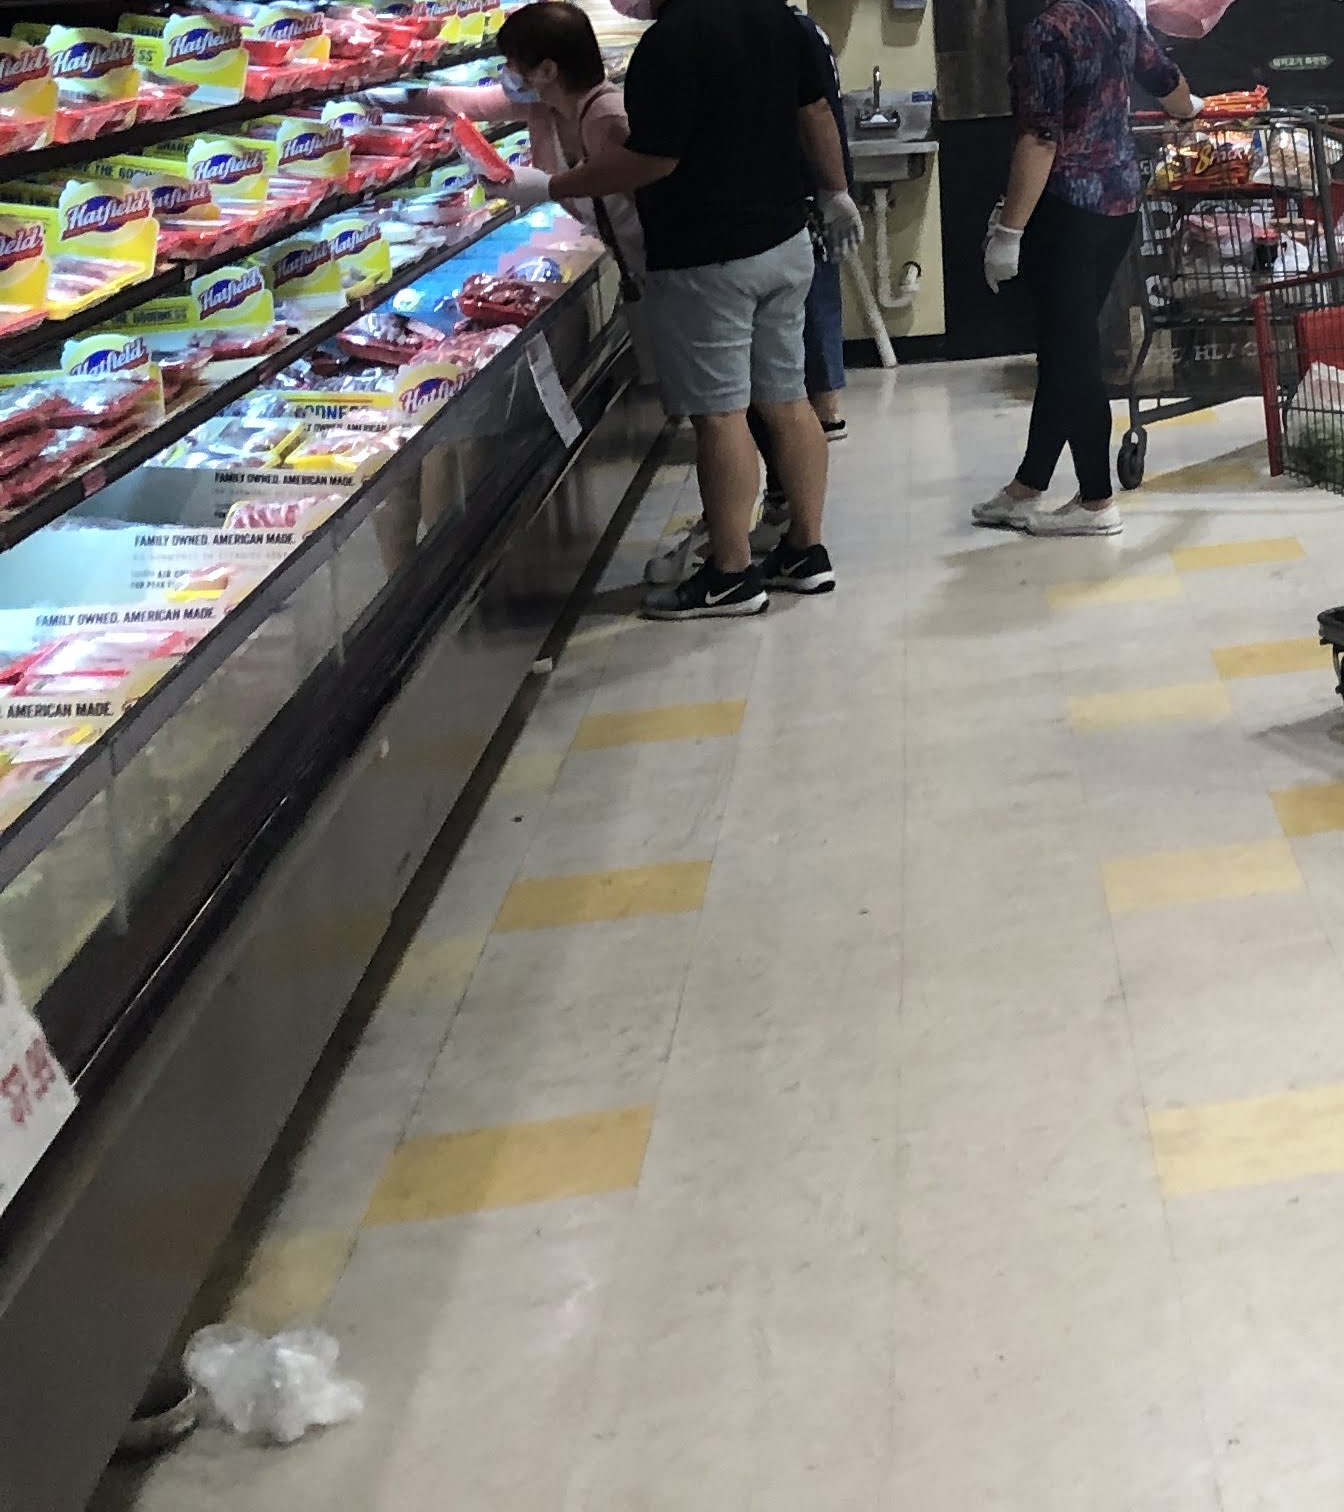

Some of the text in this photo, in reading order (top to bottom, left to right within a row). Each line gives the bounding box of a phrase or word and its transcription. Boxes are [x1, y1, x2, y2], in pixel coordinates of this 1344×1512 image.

[259, 13, 324, 39] Hatfield
[51, 39, 133, 77] Hatfield
[168, 25, 242, 63] Hatfield
[282, 129, 344, 160] Hatfield
[194, 151, 265, 181] Hatfield
[64, 188, 151, 233] Hatfield
[330, 221, 380, 255] Hatfield
[276, 240, 330, 278] Hatfield
[200, 267, 262, 306] Hatfield
[283, 475, 327, 485] AMERICAN
[134, 534, 169, 547] FAMILY
[212, 533, 263, 545] AMERICAN
[265, 533, 296, 544] MADE.
[35, 614, 74, 626] FAMILY
[123, 610, 180, 623] AMERICAN
[183, 607, 216, 620] MADE.
[7, 701, 113, 718] AMERICAN MADE.
